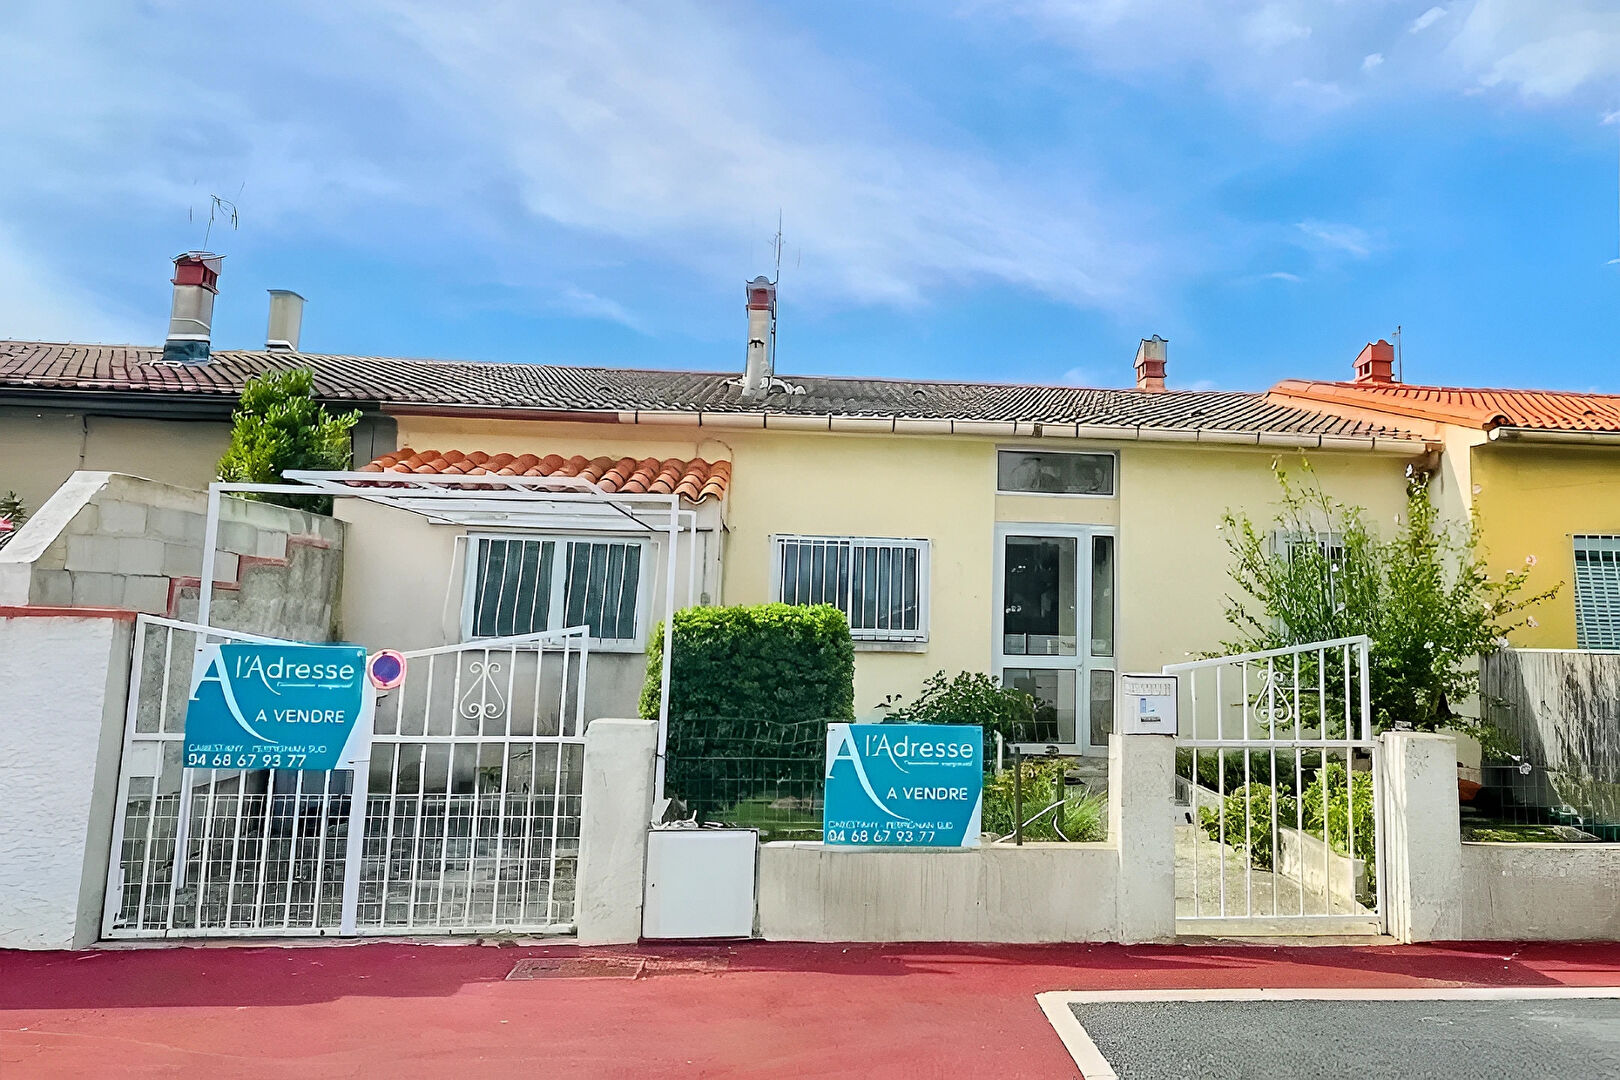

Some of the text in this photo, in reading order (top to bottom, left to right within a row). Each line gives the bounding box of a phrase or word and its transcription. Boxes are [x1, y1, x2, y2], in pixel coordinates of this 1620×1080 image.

[236, 655, 355, 695] l'Adresse
[255, 709, 345, 723] A VENDRE
[865, 733, 974, 773] l'Adresse
[212, 754, 231, 766] 68
[237, 754, 257, 767] 67
[262, 754, 281, 767] 93
[287, 754, 307, 767] 77
[887, 787, 968, 800] A VENDRE
[851, 830, 868, 842] 68
[873, 830, 891, 842] 67
[896, 830, 913, 842] 93
[919, 831, 935, 842] 77
